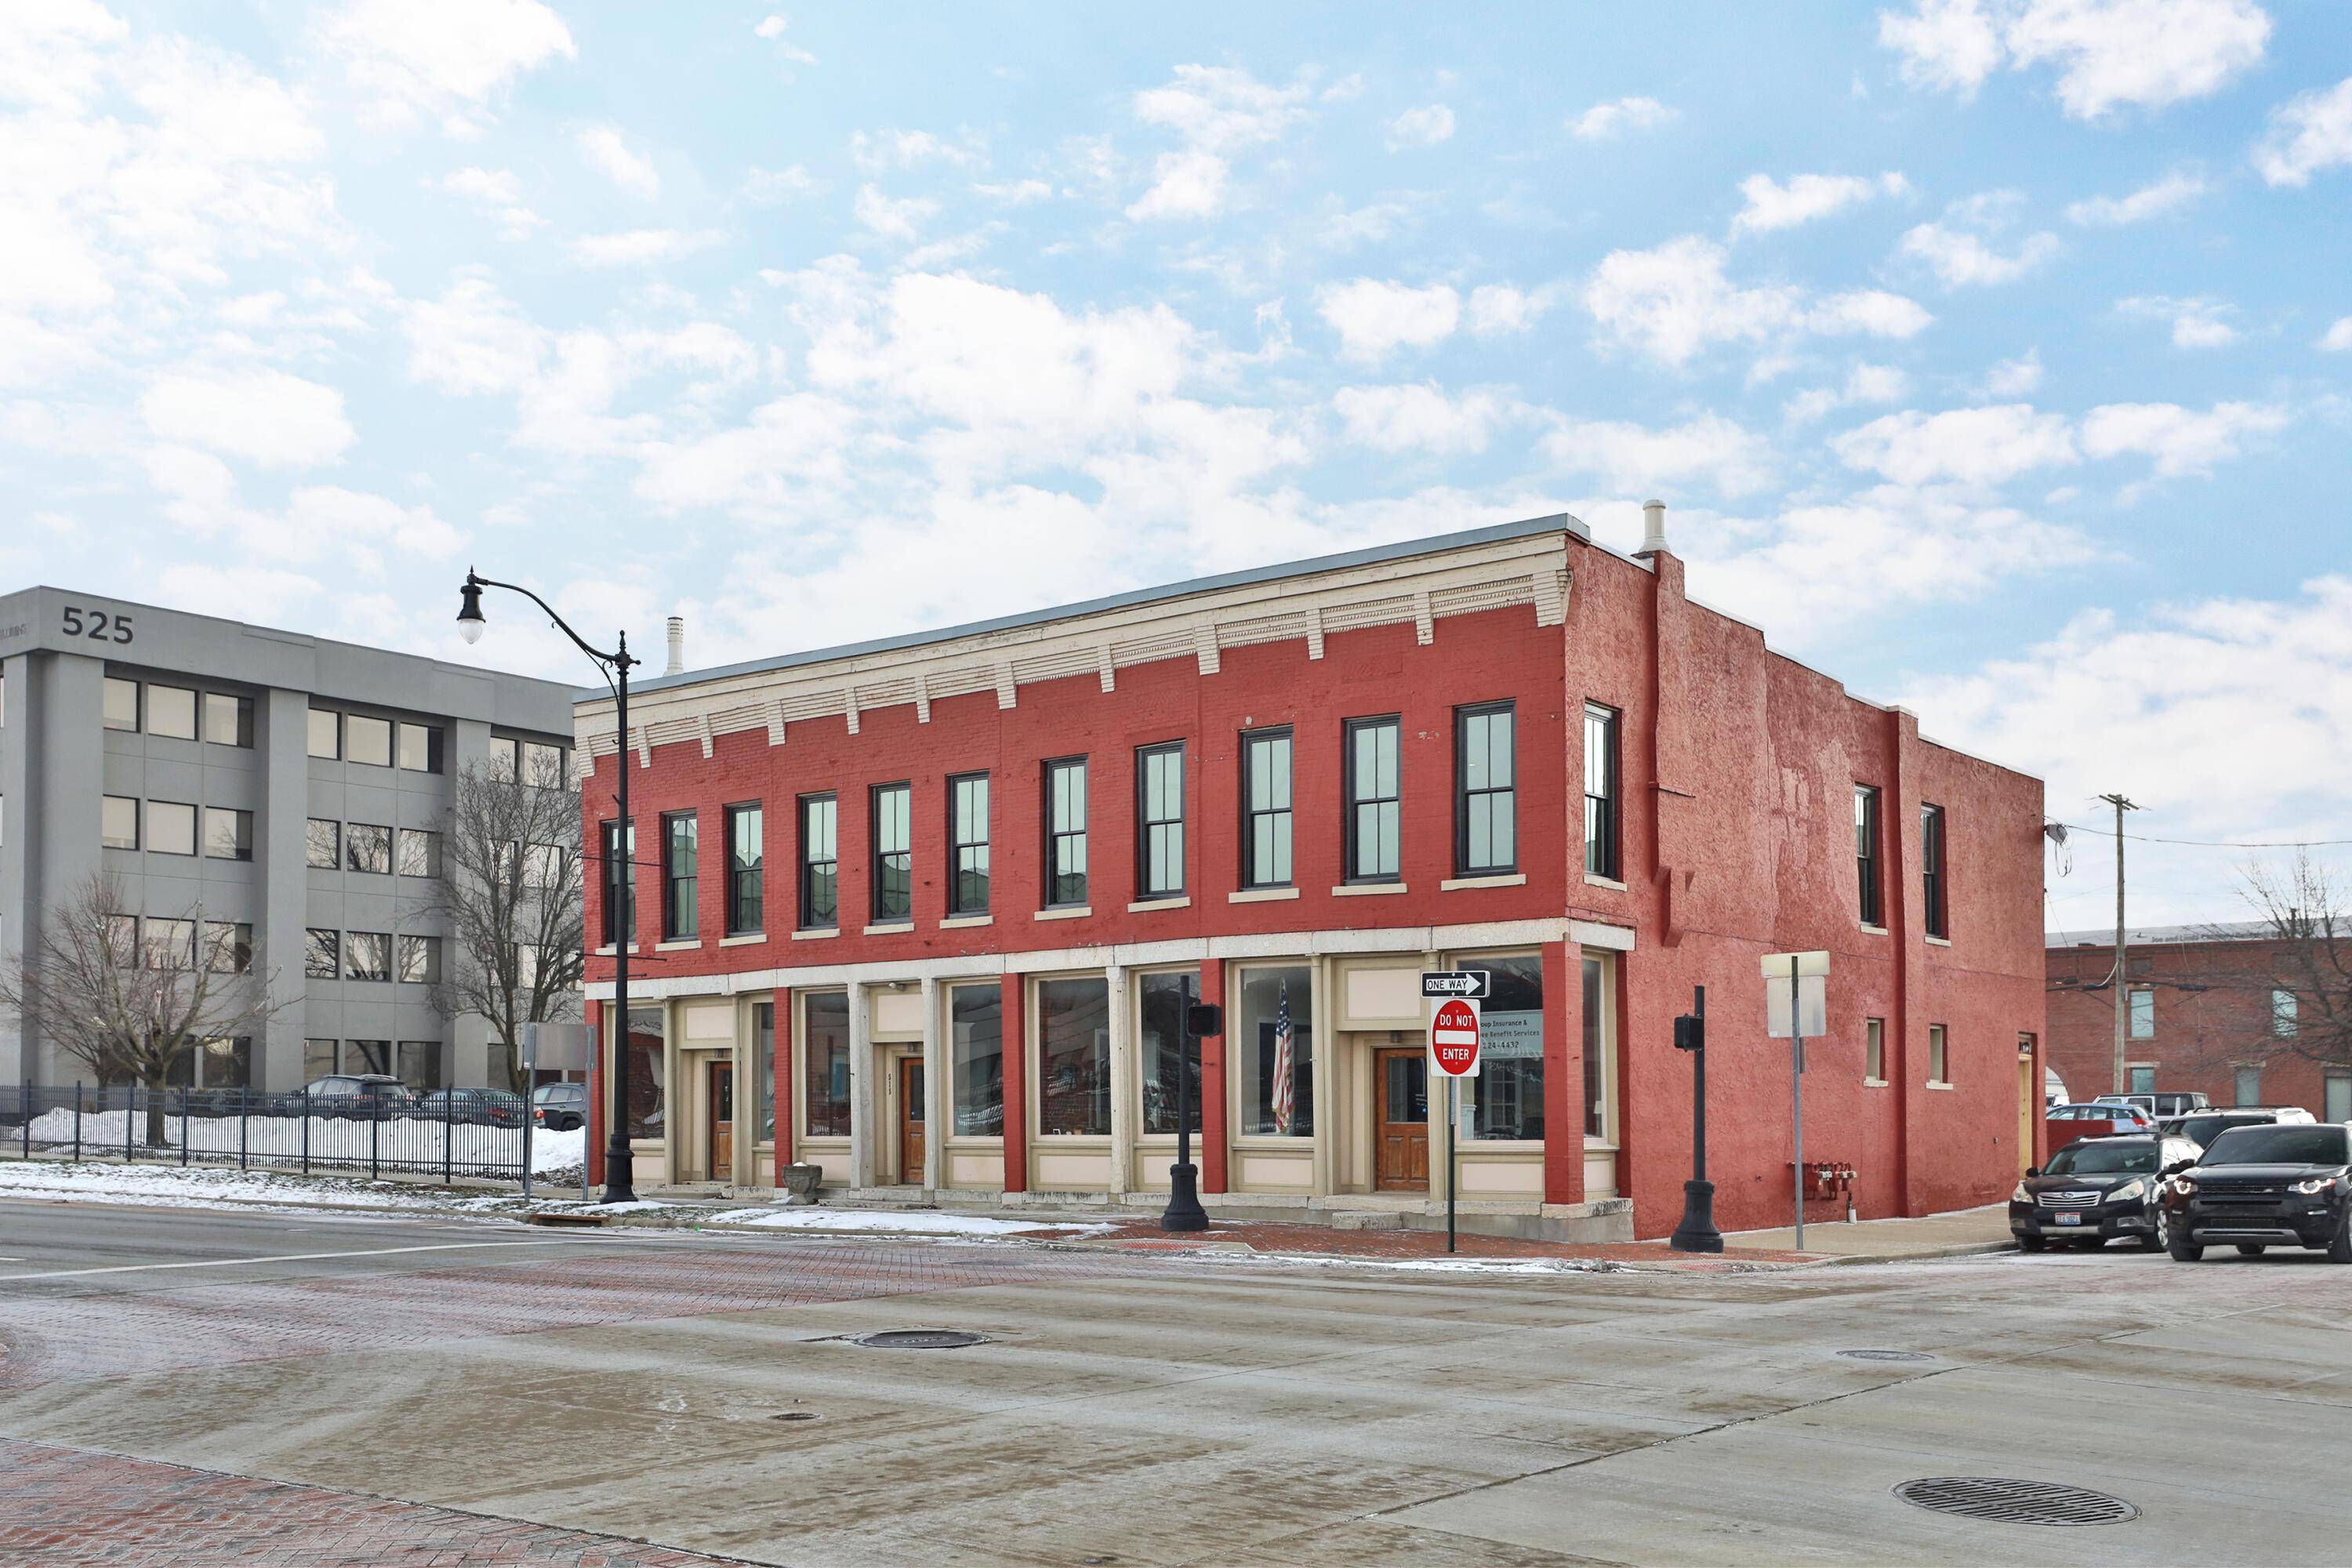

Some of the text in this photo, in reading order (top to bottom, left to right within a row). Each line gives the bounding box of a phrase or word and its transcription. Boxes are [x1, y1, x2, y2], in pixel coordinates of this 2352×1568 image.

[63, 606, 133, 644] 525
[1427, 979, 1468, 989] ONE WAY
[1439, 1014, 1473, 1027] DO NOT
[1443, 1048, 1469, 1060] ENTER
